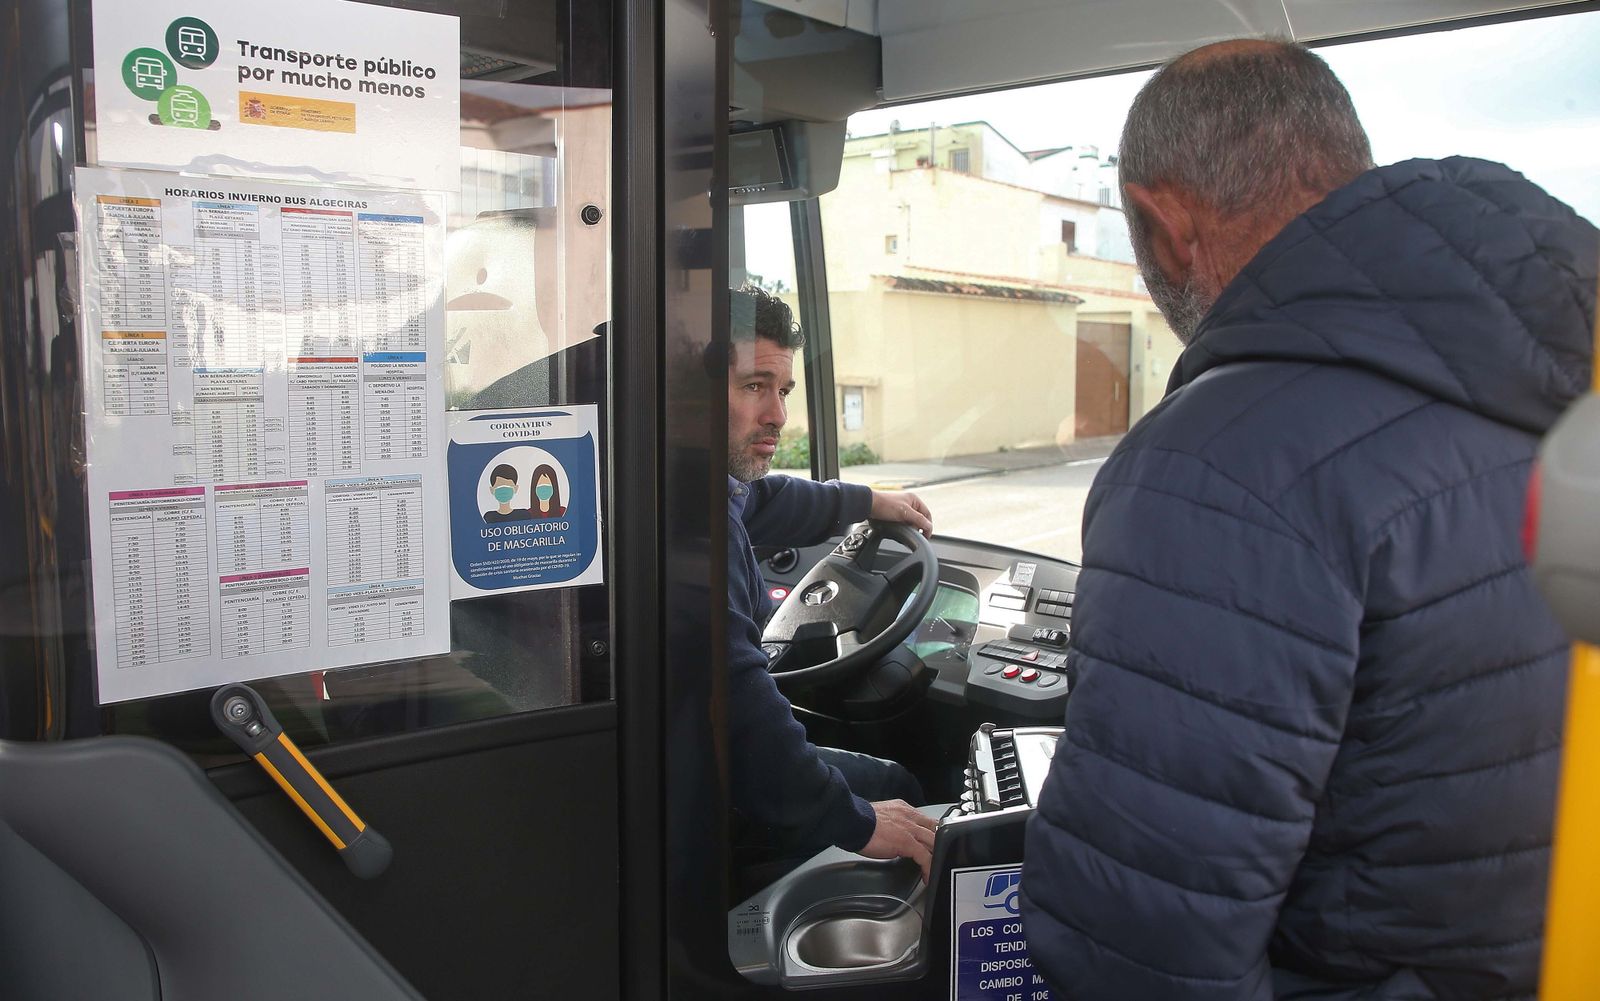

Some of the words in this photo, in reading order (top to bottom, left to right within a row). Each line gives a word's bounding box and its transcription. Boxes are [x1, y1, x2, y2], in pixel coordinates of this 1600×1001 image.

[236, 40, 358, 70] Transporte
[364, 56, 436, 80] público
[238, 64, 274, 84] por
[280, 72, 352, 90] mucho
[358, 80, 426, 99] menos
[165, 188, 225, 200] HORARIOS
[228, 192, 282, 204] INVIERNO
[284, 196, 306, 206] BUS
[308, 198, 368, 210] ALGECIRAS
[490, 420, 552, 430] CORONAVIRUS
[502, 430, 541, 439] COVID-19
[480, 527, 502, 538] USO
[503, 521, 570, 536] OBLIGATORIO
[488, 541, 502, 552] DE
[503, 535, 566, 550] MASCARILLA
[970, 926, 994, 938] LOS
[1002, 922, 1022, 935] CO
[993, 940, 1027, 954] TEND
[979, 976, 1024, 990] CAMBIO
[1032, 974, 1044, 985] M
[1006, 993, 1022, 1001] DE
[1030, 990, 1049, 1001] 10€
